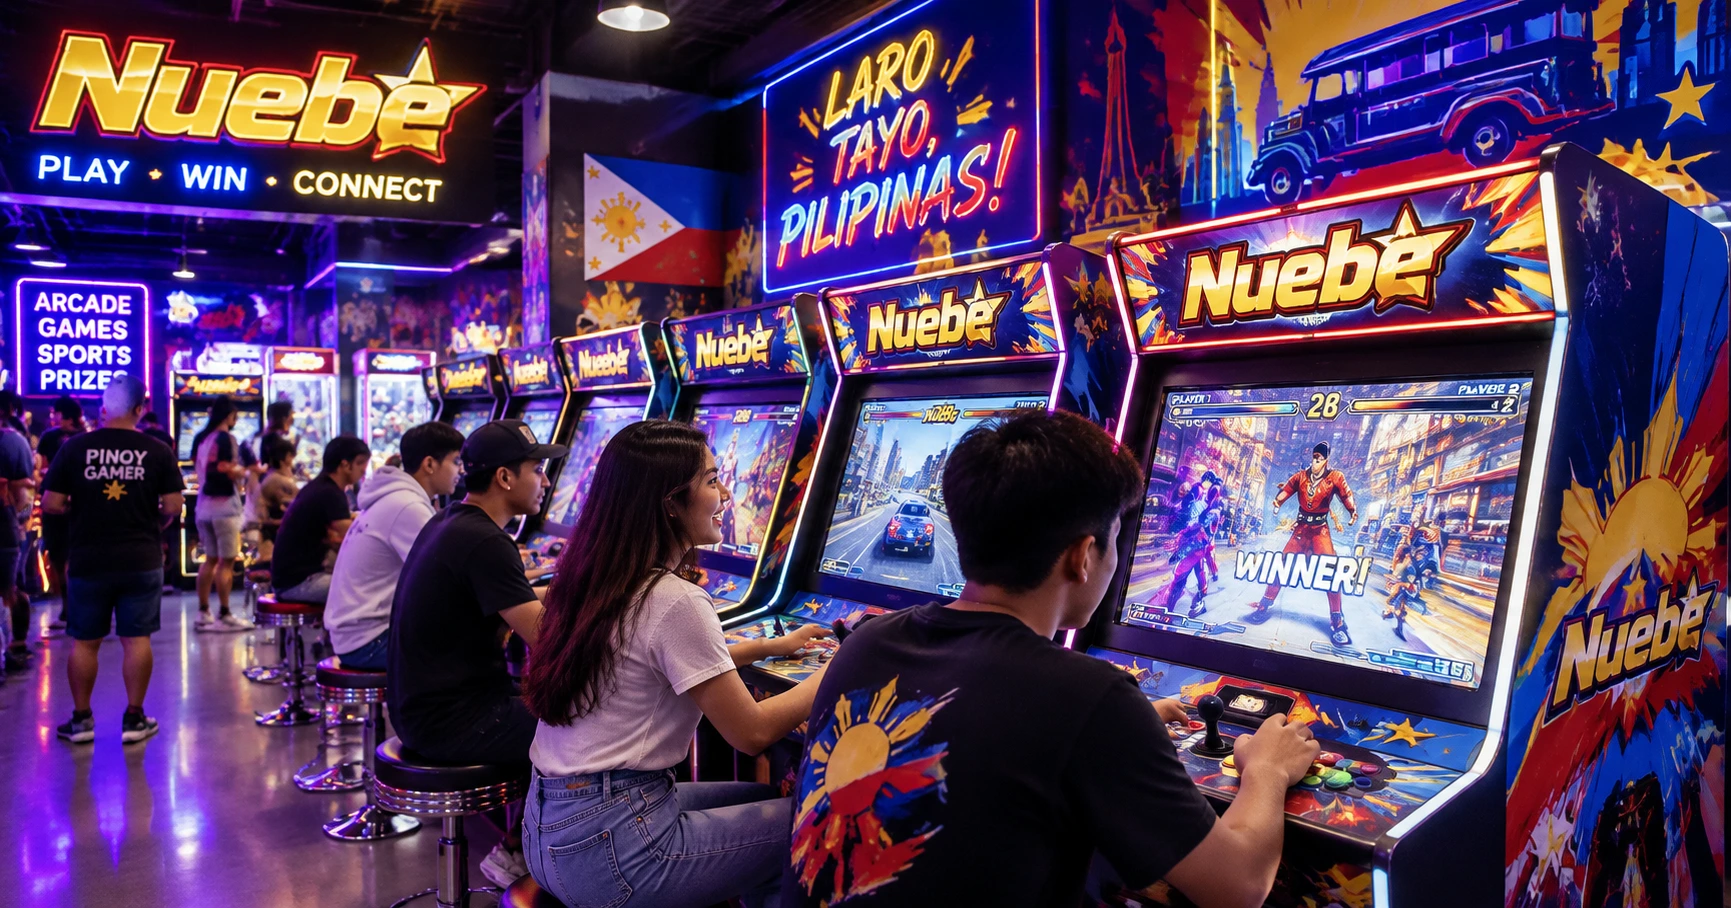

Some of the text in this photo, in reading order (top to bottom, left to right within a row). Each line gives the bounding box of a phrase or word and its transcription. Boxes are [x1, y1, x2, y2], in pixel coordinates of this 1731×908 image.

[38, 34, 456, 160] Nuebe
[823, 30, 934, 130] LARO
[829, 99, 937, 185] TAYO,
[38, 154, 443, 203] PLAY WIN CONNECT
[776, 127, 1017, 270] PILIPINAS!
[1181, 226, 1438, 321] Nuebe
[34, 292, 132, 315] ARCADE
[38, 318, 128, 340] GAMES
[868, 291, 994, 353] Nuebe
[37, 344, 132, 366] SPORTS
[695, 323, 772, 369] Nuebe
[84, 466, 146, 481] GAMER
[86, 449, 148, 465] PINOY
[1235, 545, 1373, 596] WINNER!
[1552, 588, 1706, 707] Nuebe
